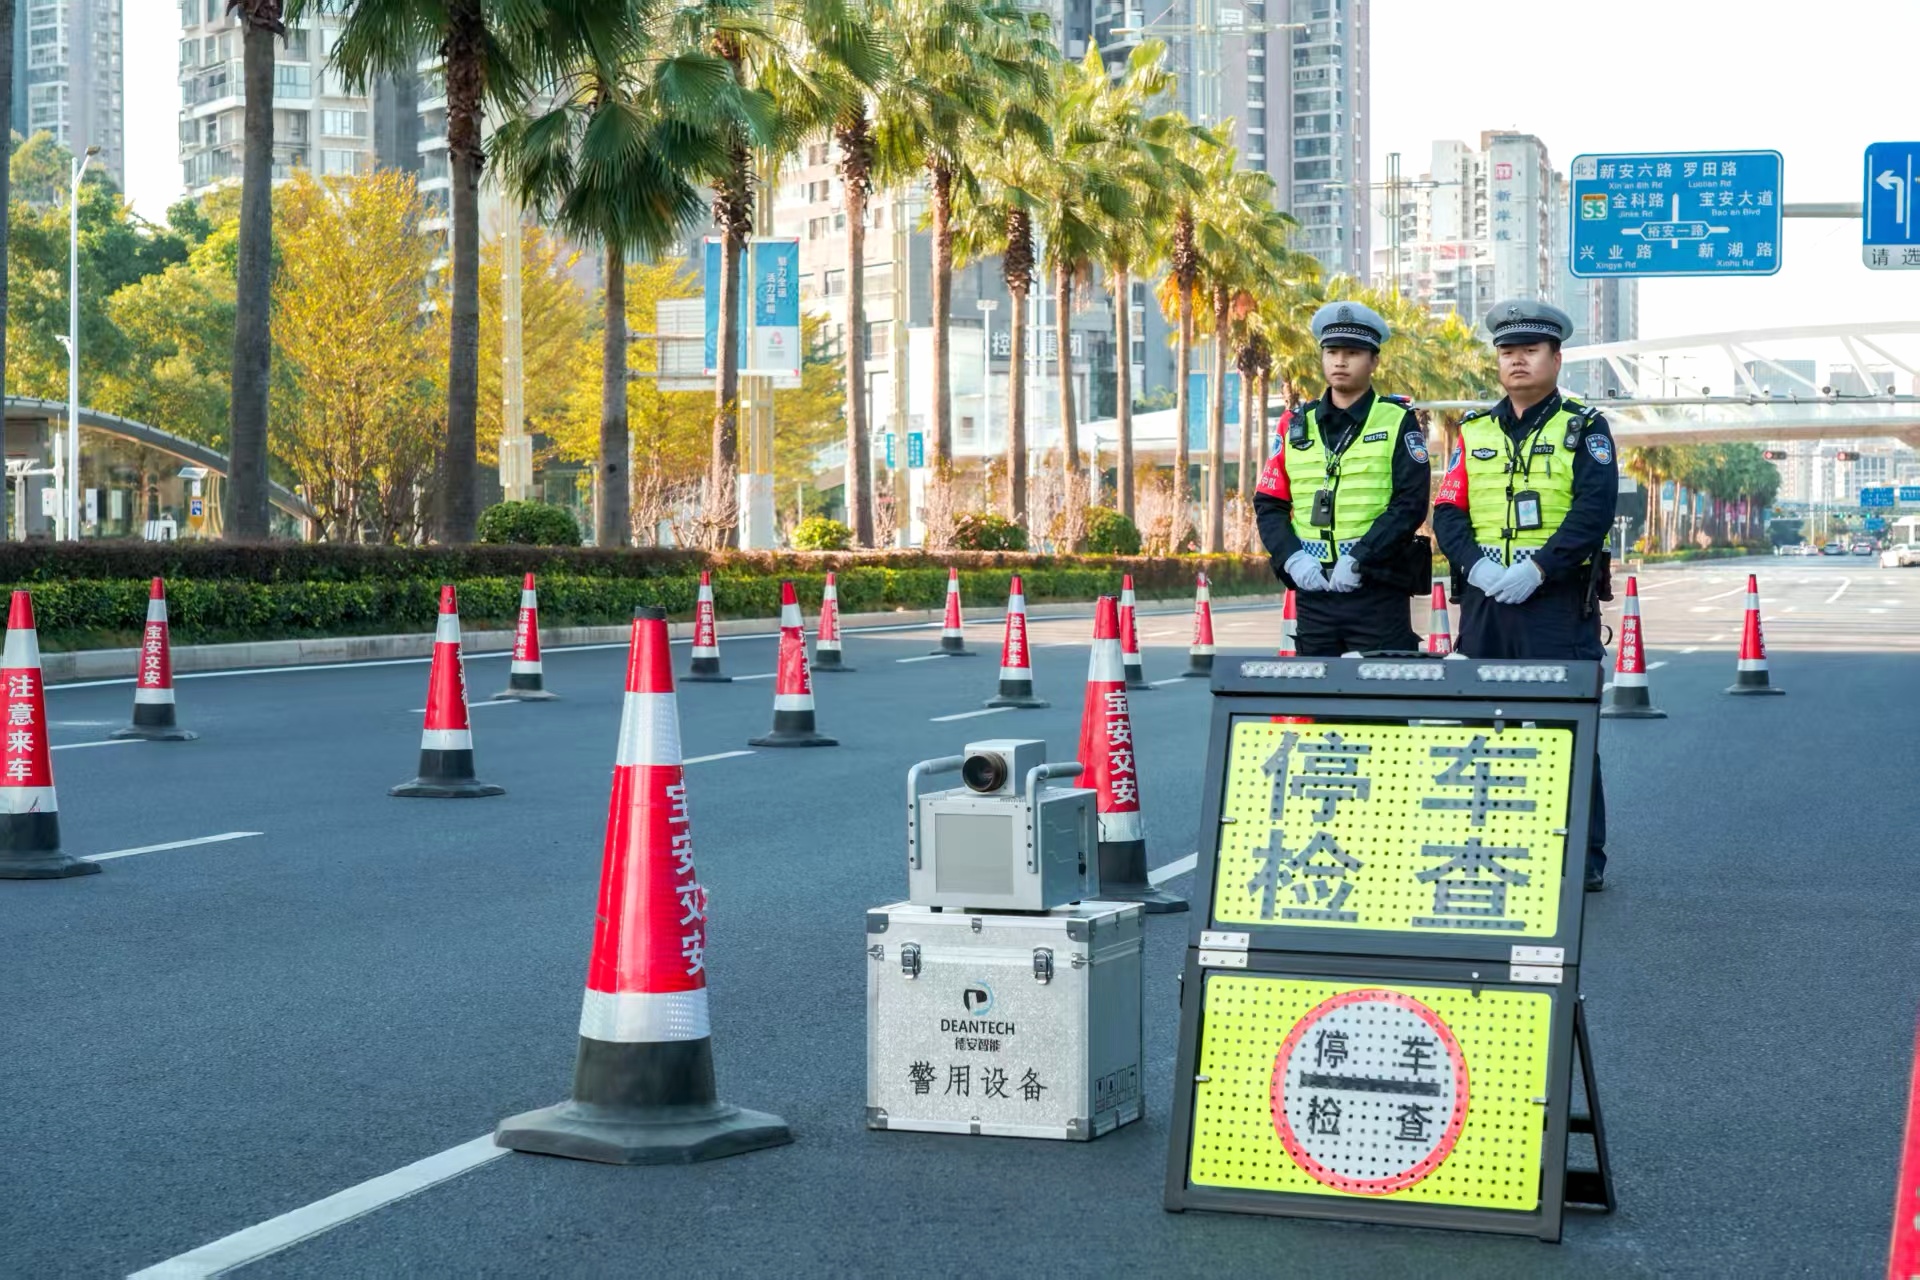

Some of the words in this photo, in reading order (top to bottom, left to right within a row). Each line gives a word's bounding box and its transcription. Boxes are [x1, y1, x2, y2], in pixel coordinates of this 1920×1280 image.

[1574, 163, 1587, 176] 北
[1600, 162, 1673, 179] 新安六路
[1683, 160, 1737, 178] 罗田路
[1651, 181, 1663, 189] Rd
[1688, 180, 1718, 188] Luotian
[1720, 179, 1732, 187] Rd
[1612, 193, 1664, 209] 金科路
[1699, 190, 1773, 206] 宝安大道
[1583, 201, 1606, 218] S3
[1618, 210, 1639, 218] Jinke
[1742, 208, 1761, 216] Blvd
[1647, 224, 1704, 238] 裕安一路
[1580, 244, 1652, 260] 兴业路
[1698, 241, 1773, 258] 新湖路
[1872, 247, 1920, 266] 请选
[1595, 262, 1622, 270] Xingye
[1625, 261, 1636, 269] Rd
[1716, 259, 1740, 267] Xinhu
[1742, 259, 1754, 267] Rd
[991, 331, 1082, 357] 控集团
[515, 610, 529, 659] 注意来车
[1009, 615, 1022, 666] 注意来车
[1622, 618, 1637, 672] 请勿横穿
[143, 625, 163, 685] 宝安交安
[6, 674, 35, 782] 注意来车
[1104, 690, 1137, 804] 宝安交安
[1260, 731, 1538, 827] 停车
[1246, 828, 1532, 932] 检查
[941, 1018, 1015, 1035] DEANTECH
[955, 1036, 1001, 1052] 德安智能
[1313, 1028, 1437, 1075] 停车
[907, 1060, 1048, 1102] 警用设备
[1306, 1096, 1433, 1143] 检查
